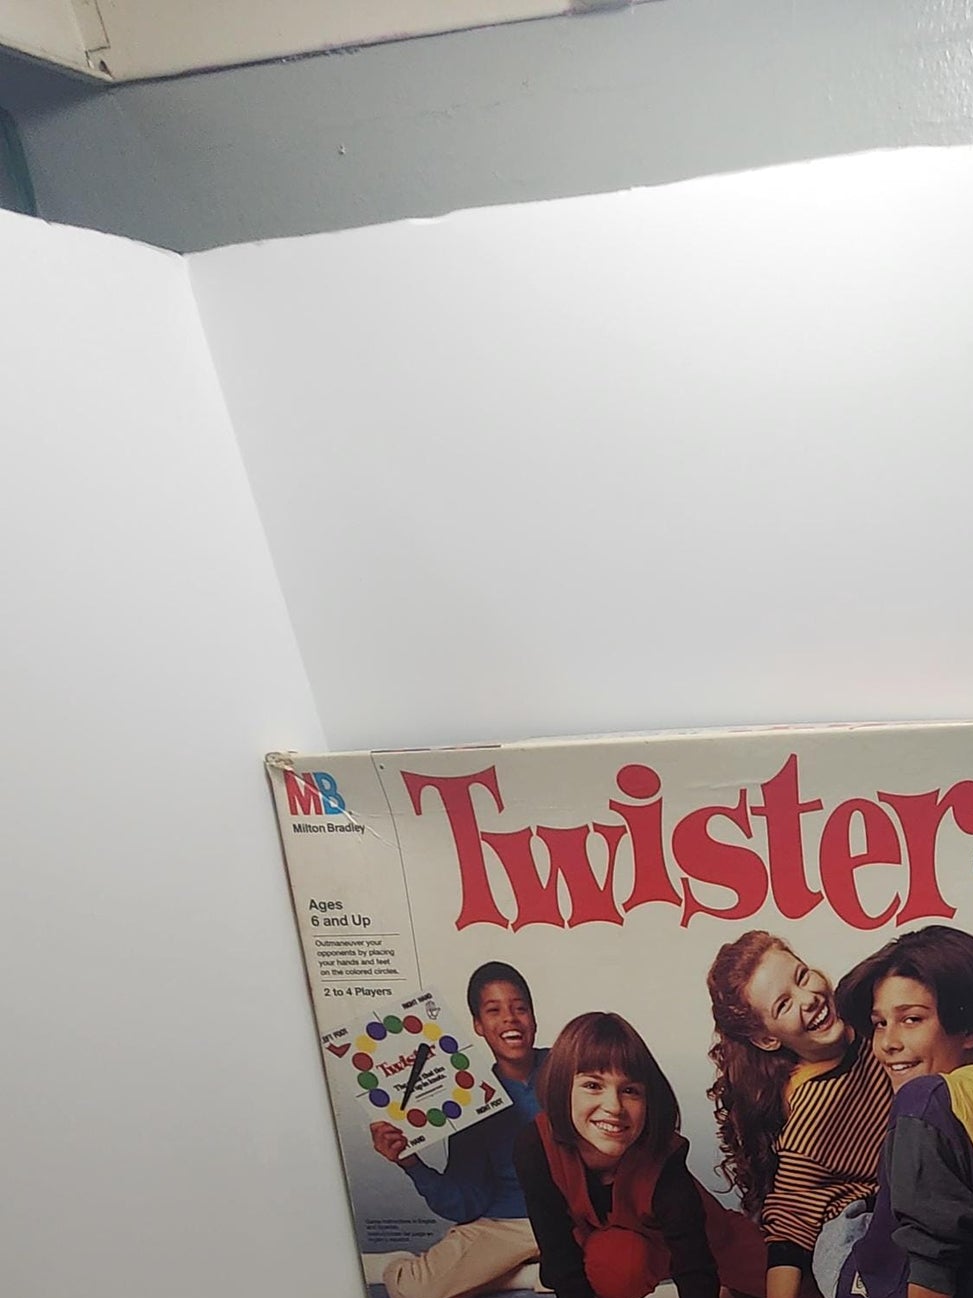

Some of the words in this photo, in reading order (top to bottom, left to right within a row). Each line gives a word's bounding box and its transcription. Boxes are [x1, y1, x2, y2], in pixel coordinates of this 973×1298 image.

[283, 770, 346, 816] MB
[293, 823, 326, 834] Milton
[327, 823, 365, 835] Bradley
[309, 899, 343, 913] Ages
[311, 916, 320, 927] 6
[323, 915, 348, 927] and
[352, 915, 371, 929] Up
[365, 940, 382, 948] your
[357, 949, 366, 957] by
[369, 949, 395, 957] placing
[318, 960, 335, 968] your
[345, 968, 373, 976] colored
[324, 988, 331, 996] 2
[332, 988, 344, 996] to
[346, 987, 352, 996] 4
[354, 987, 392, 998] Players
